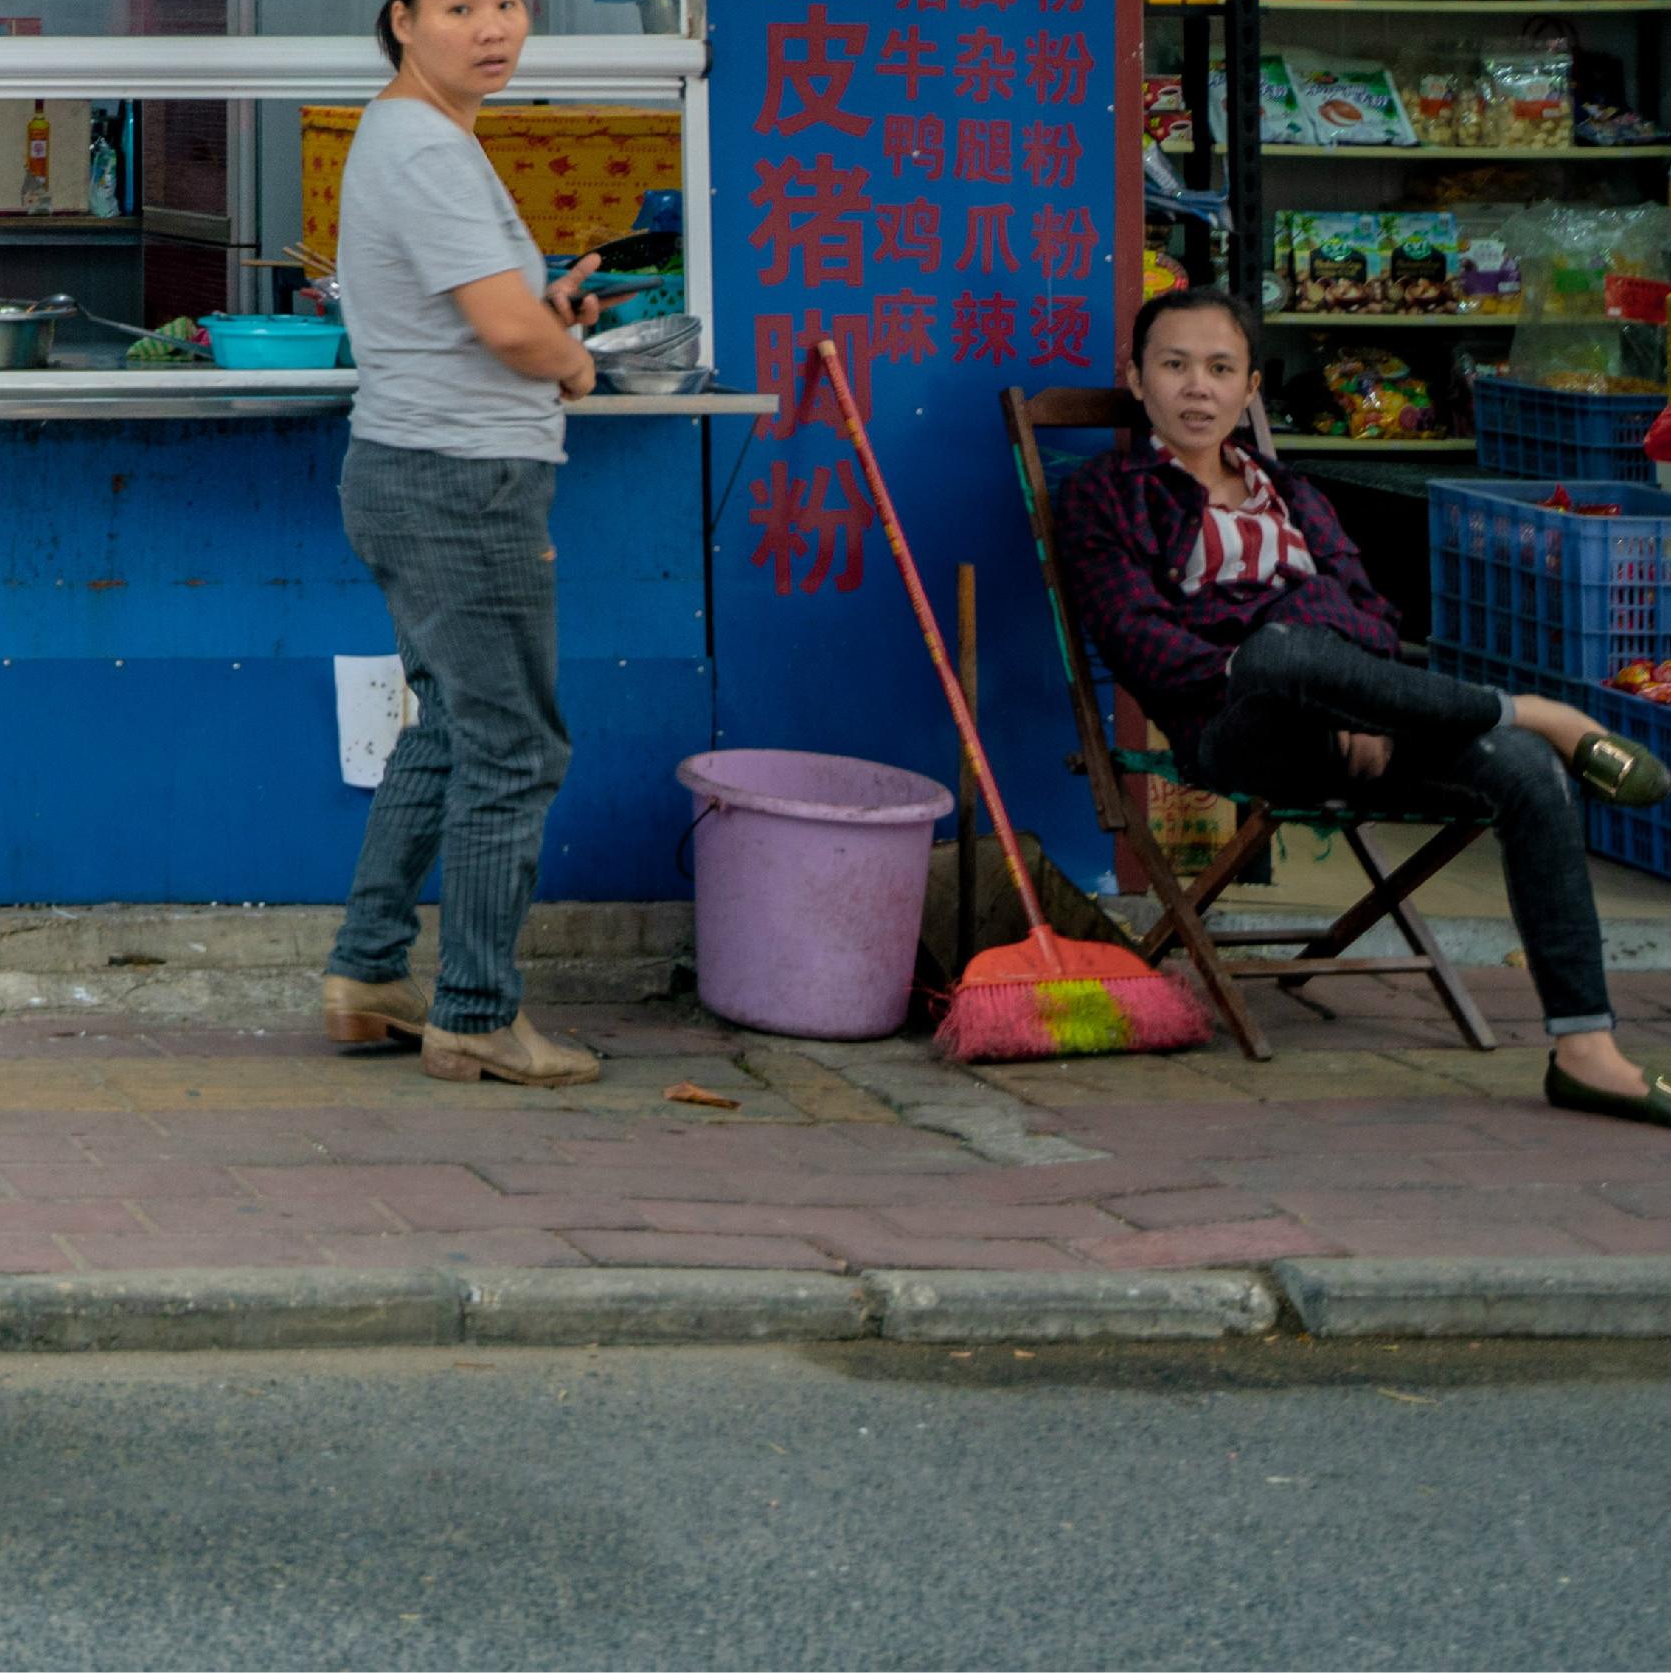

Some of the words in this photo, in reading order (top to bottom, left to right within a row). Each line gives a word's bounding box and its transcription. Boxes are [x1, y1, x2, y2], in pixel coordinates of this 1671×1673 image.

[875, 26, 1096, 106] 牛杂粉
[883, 113, 1085, 189] 鸭腿粉
[873, 200, 1100, 281] 鸡爪粉
[871, 289, 1093, 369] 麻辣烫
